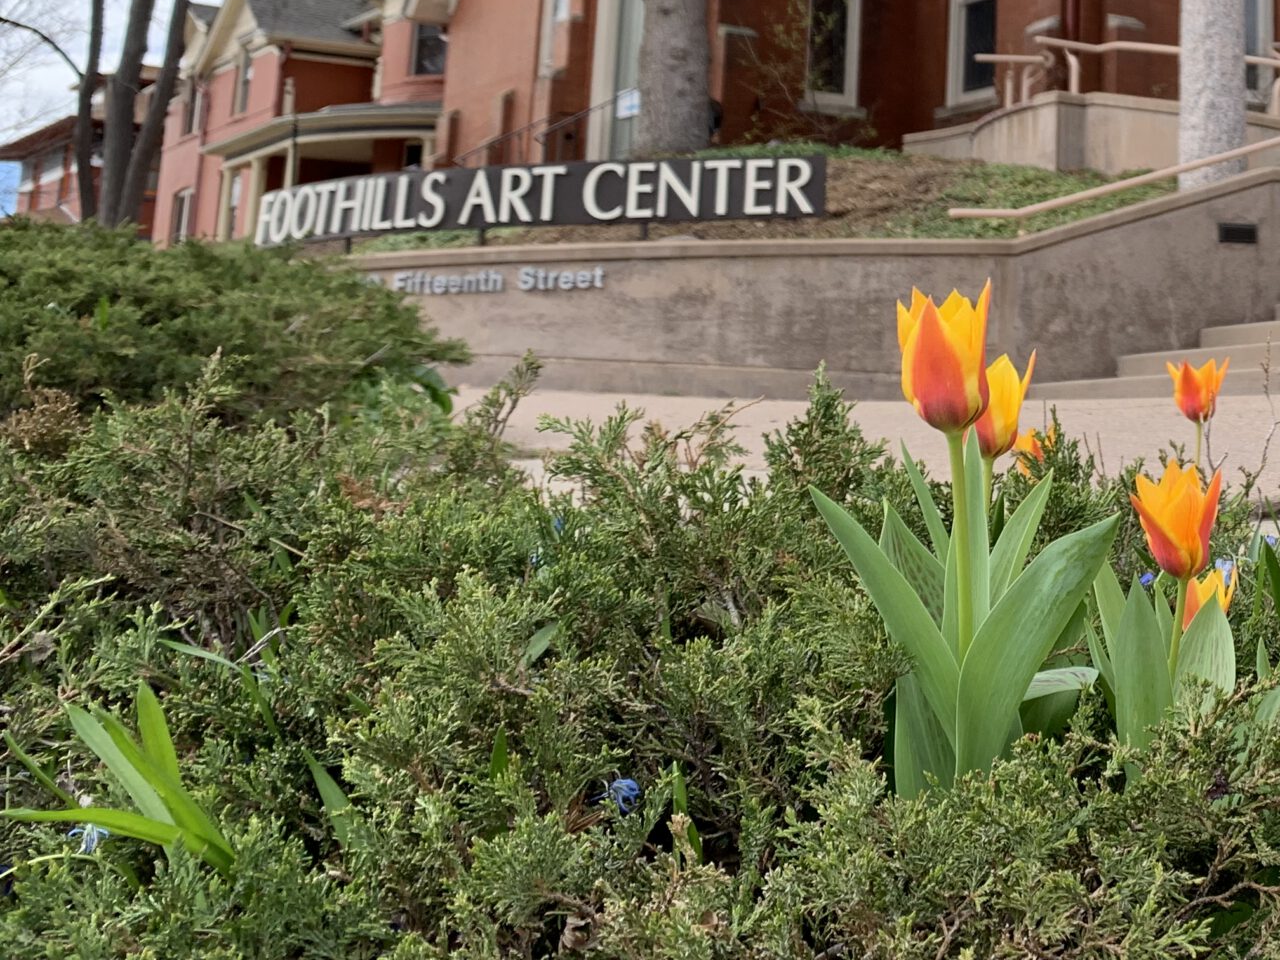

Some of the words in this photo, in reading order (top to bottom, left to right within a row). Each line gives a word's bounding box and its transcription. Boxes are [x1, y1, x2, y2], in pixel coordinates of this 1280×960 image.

[254, 171, 446, 246] FOOTHILLS
[457, 165, 568, 225] ART
[582, 158, 814, 220] CENTER
[393, 270, 504, 295] Fifteenth
[517, 265, 605, 291] Street
